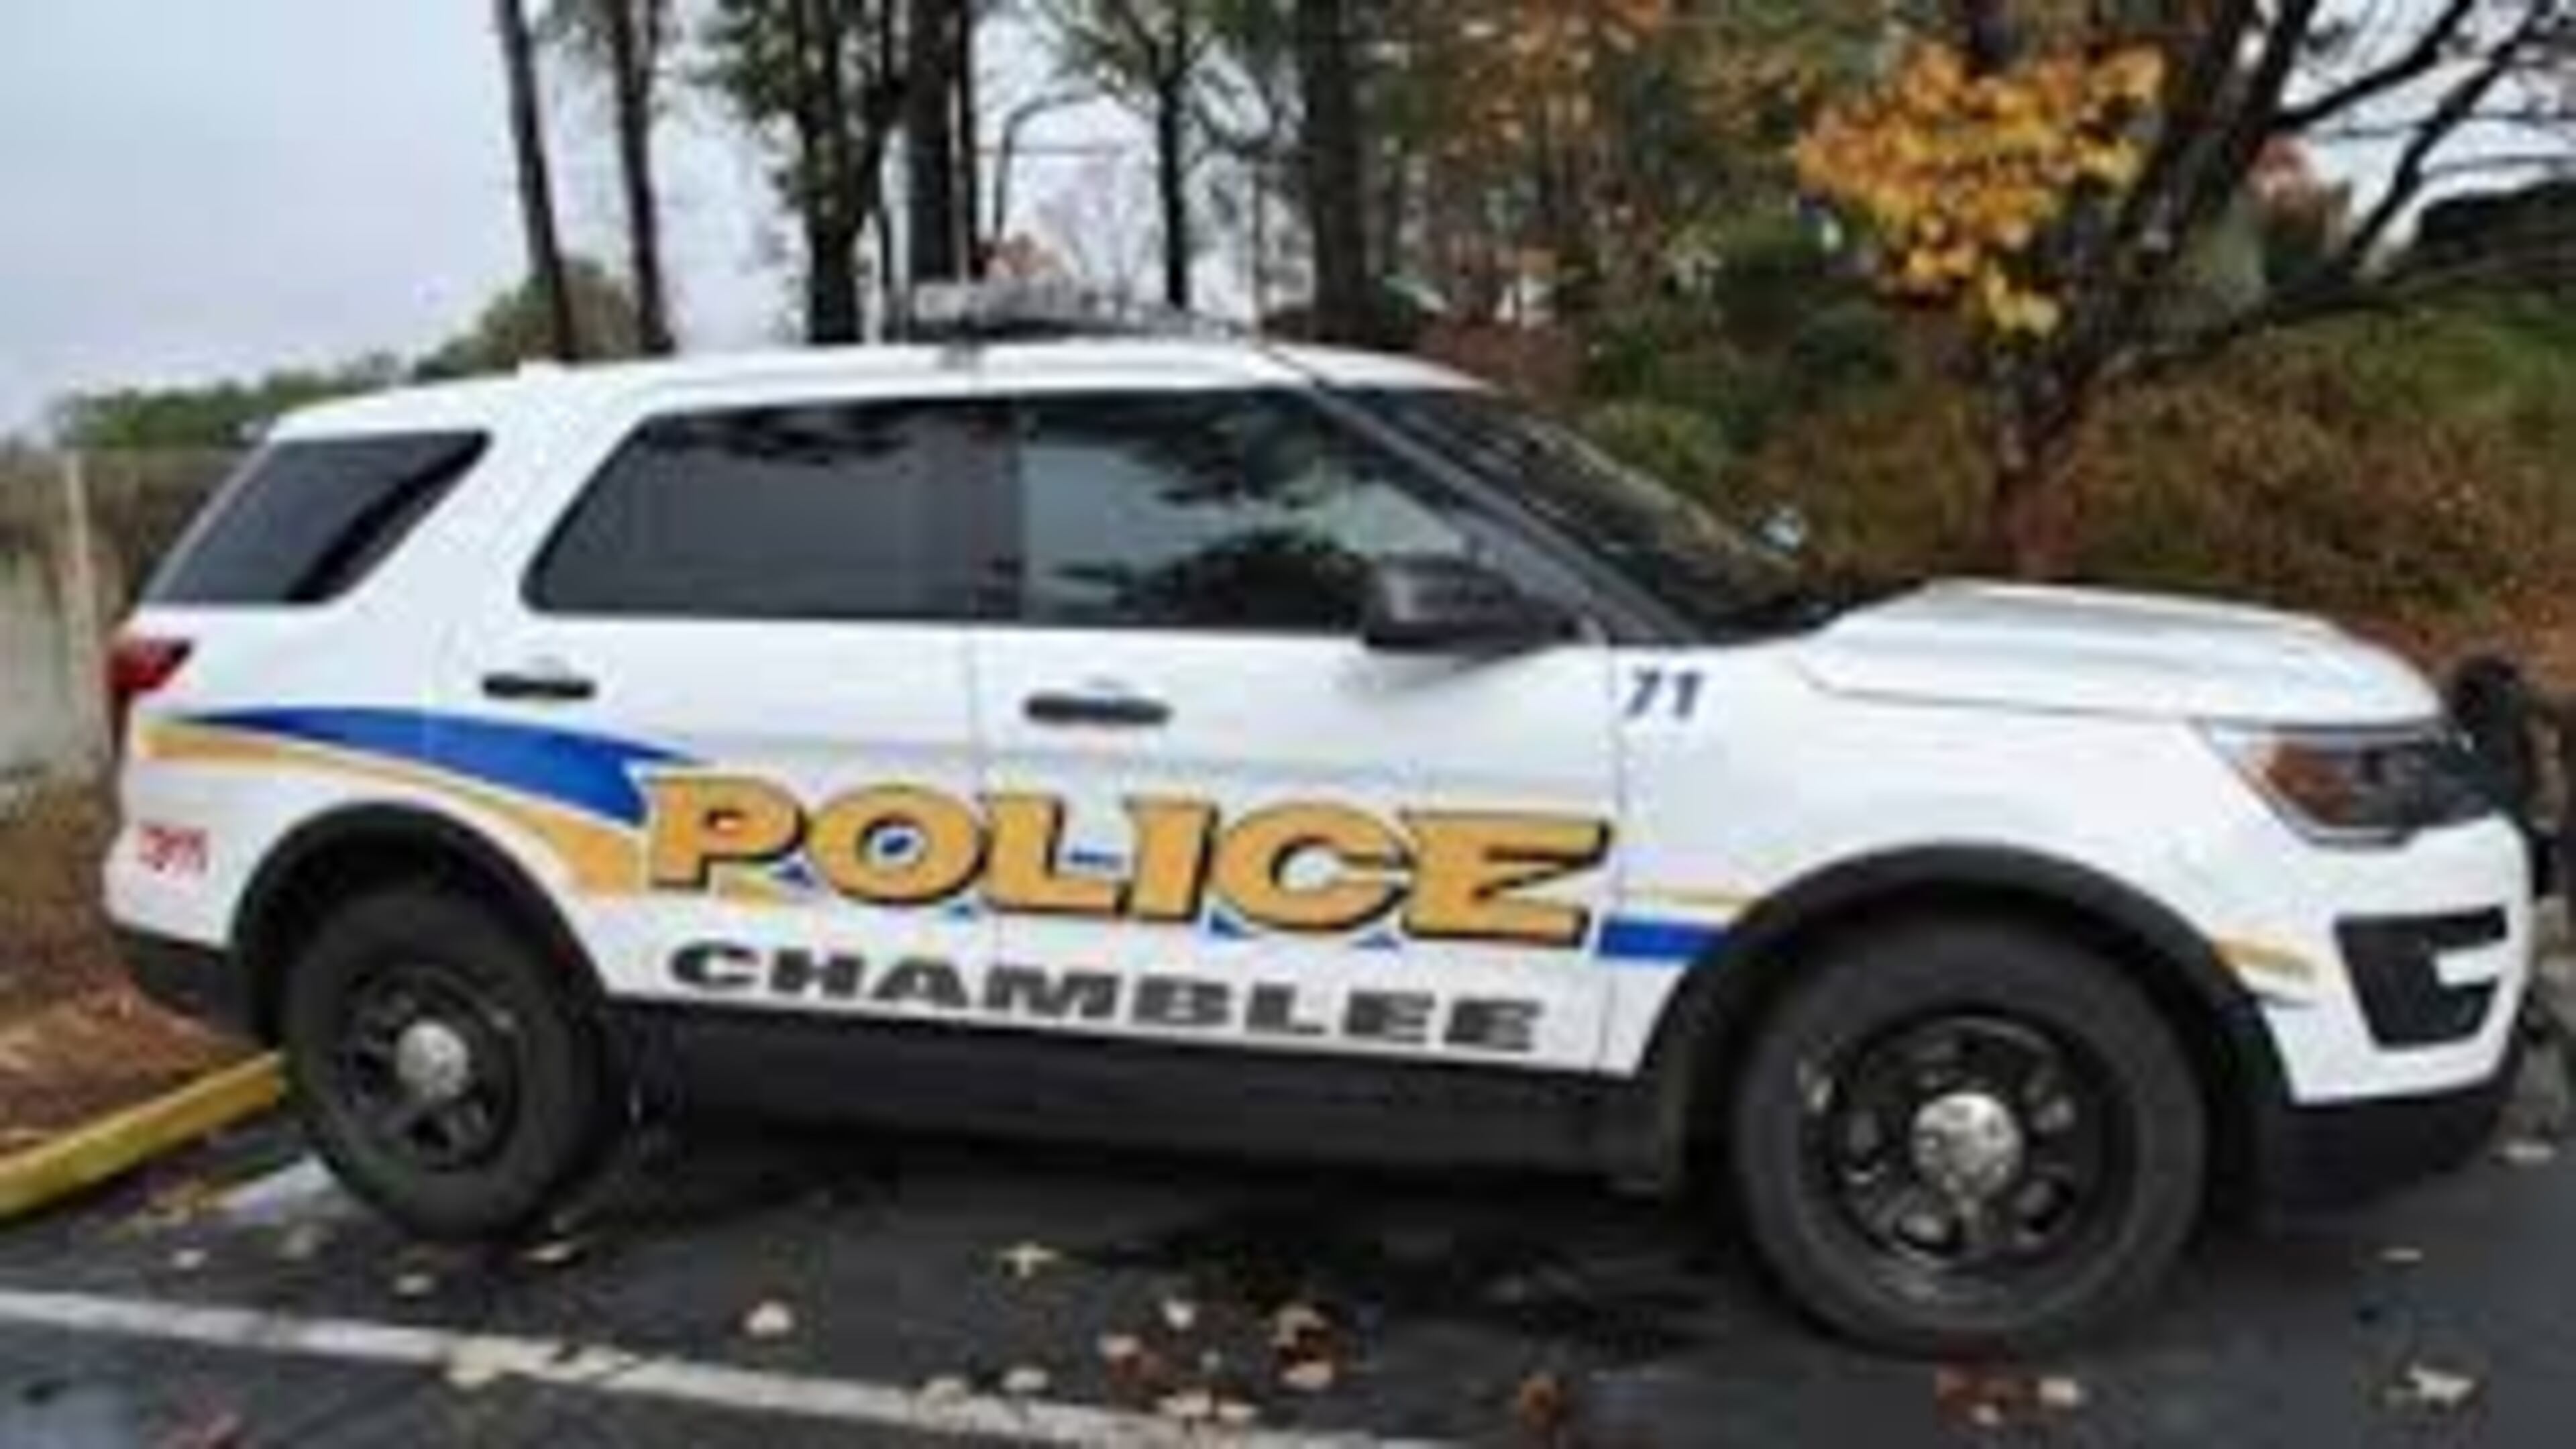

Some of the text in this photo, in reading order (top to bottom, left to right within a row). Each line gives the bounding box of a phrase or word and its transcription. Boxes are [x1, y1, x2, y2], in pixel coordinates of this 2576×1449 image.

[1623, 667, 1702, 720] 71
[643, 773, 1611, 948] POLICE
[669, 941, 1543, 1053] CHAMBLEE
